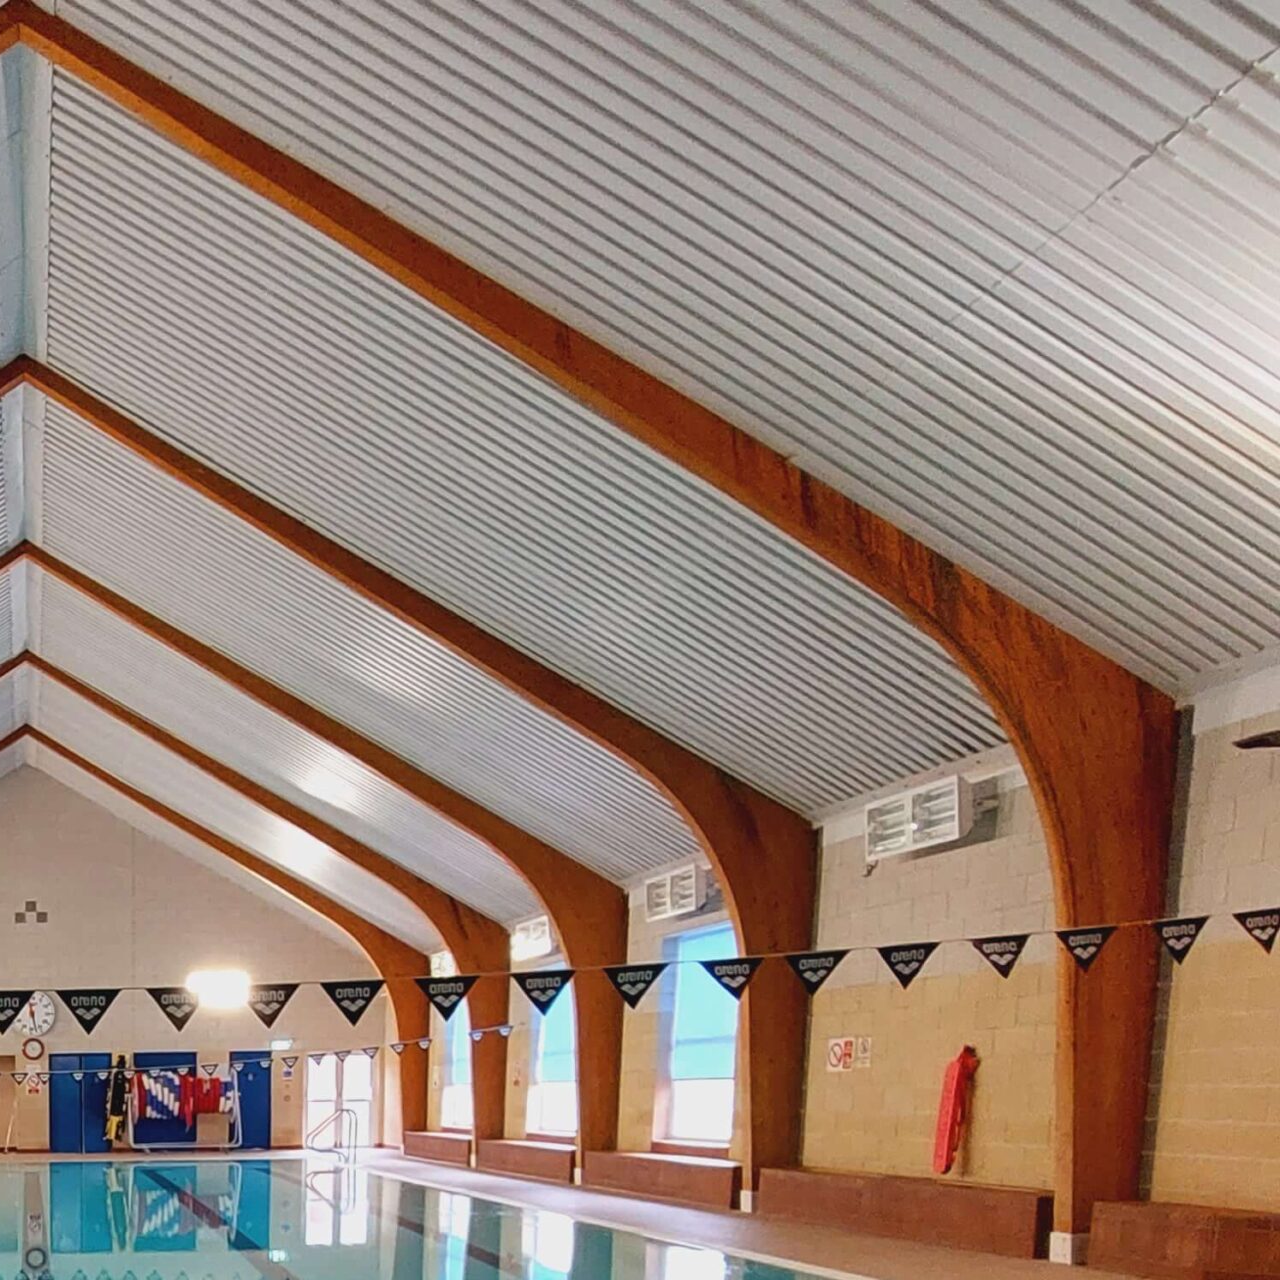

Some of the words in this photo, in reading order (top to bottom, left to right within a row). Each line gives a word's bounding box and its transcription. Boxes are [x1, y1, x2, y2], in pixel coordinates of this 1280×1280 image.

[1162, 924, 1196, 938] arena
[982, 941, 1017, 953] arena
[891, 949, 925, 963] arena
[714, 963, 750, 975] arena
[798, 956, 834, 970] arena
[617, 969, 653, 983] arena
[429, 982, 464, 994] arena
[526, 976, 561, 989] arena
[335, 987, 370, 999] arena
[71, 995, 106, 1007] arena
